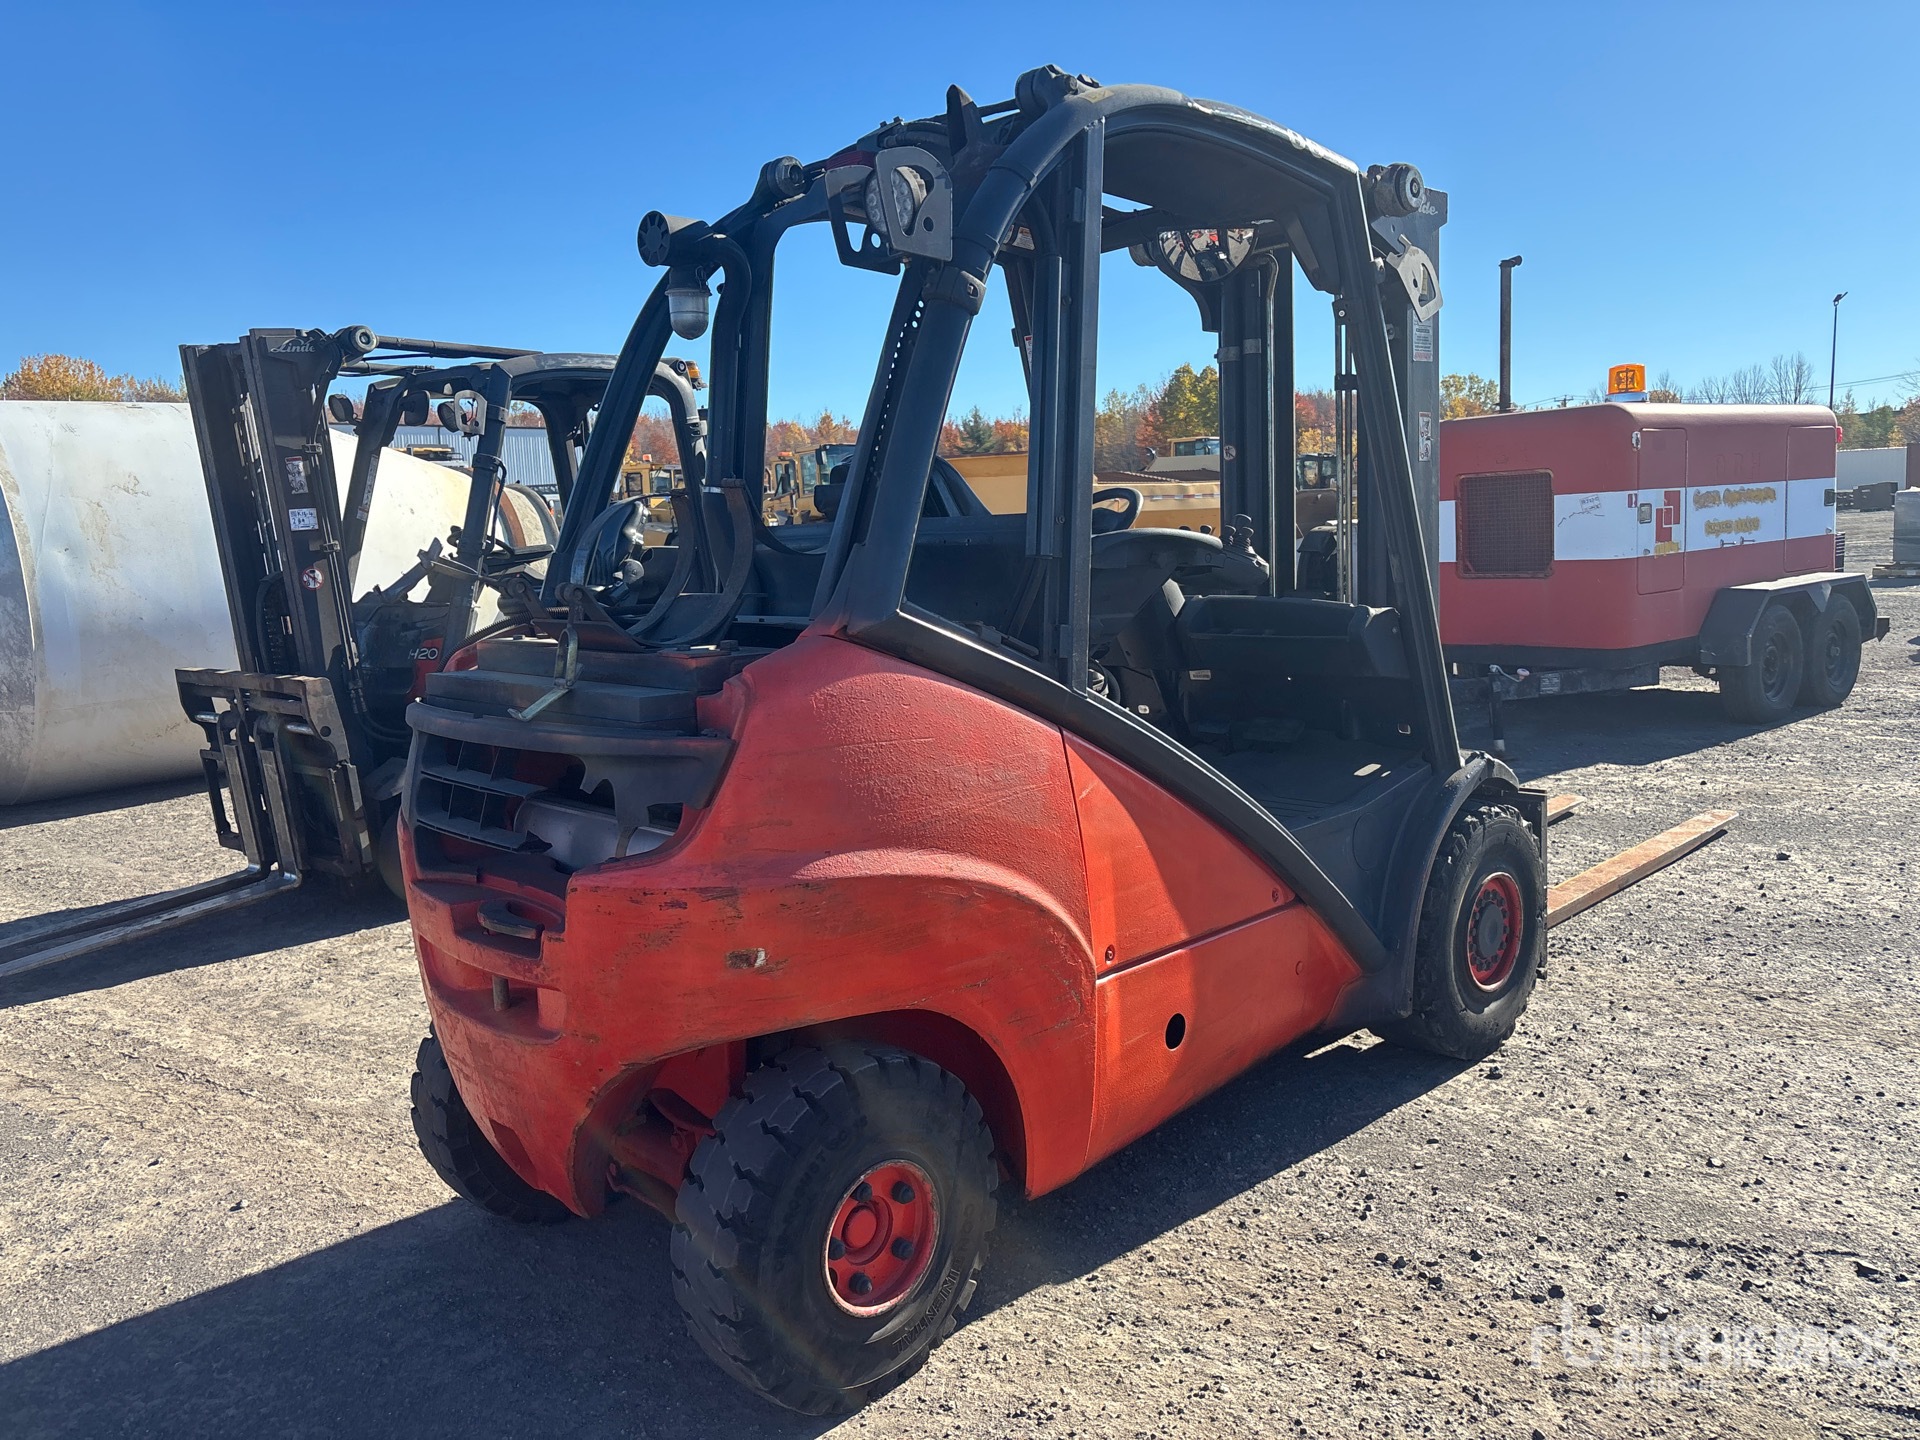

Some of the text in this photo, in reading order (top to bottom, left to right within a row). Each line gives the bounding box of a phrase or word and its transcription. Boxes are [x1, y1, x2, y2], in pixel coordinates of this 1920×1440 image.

[270, 337, 317, 353] Linde
[407, 647, 439, 660] H20
[892, 1202, 975, 1355] CONTINENTAL
